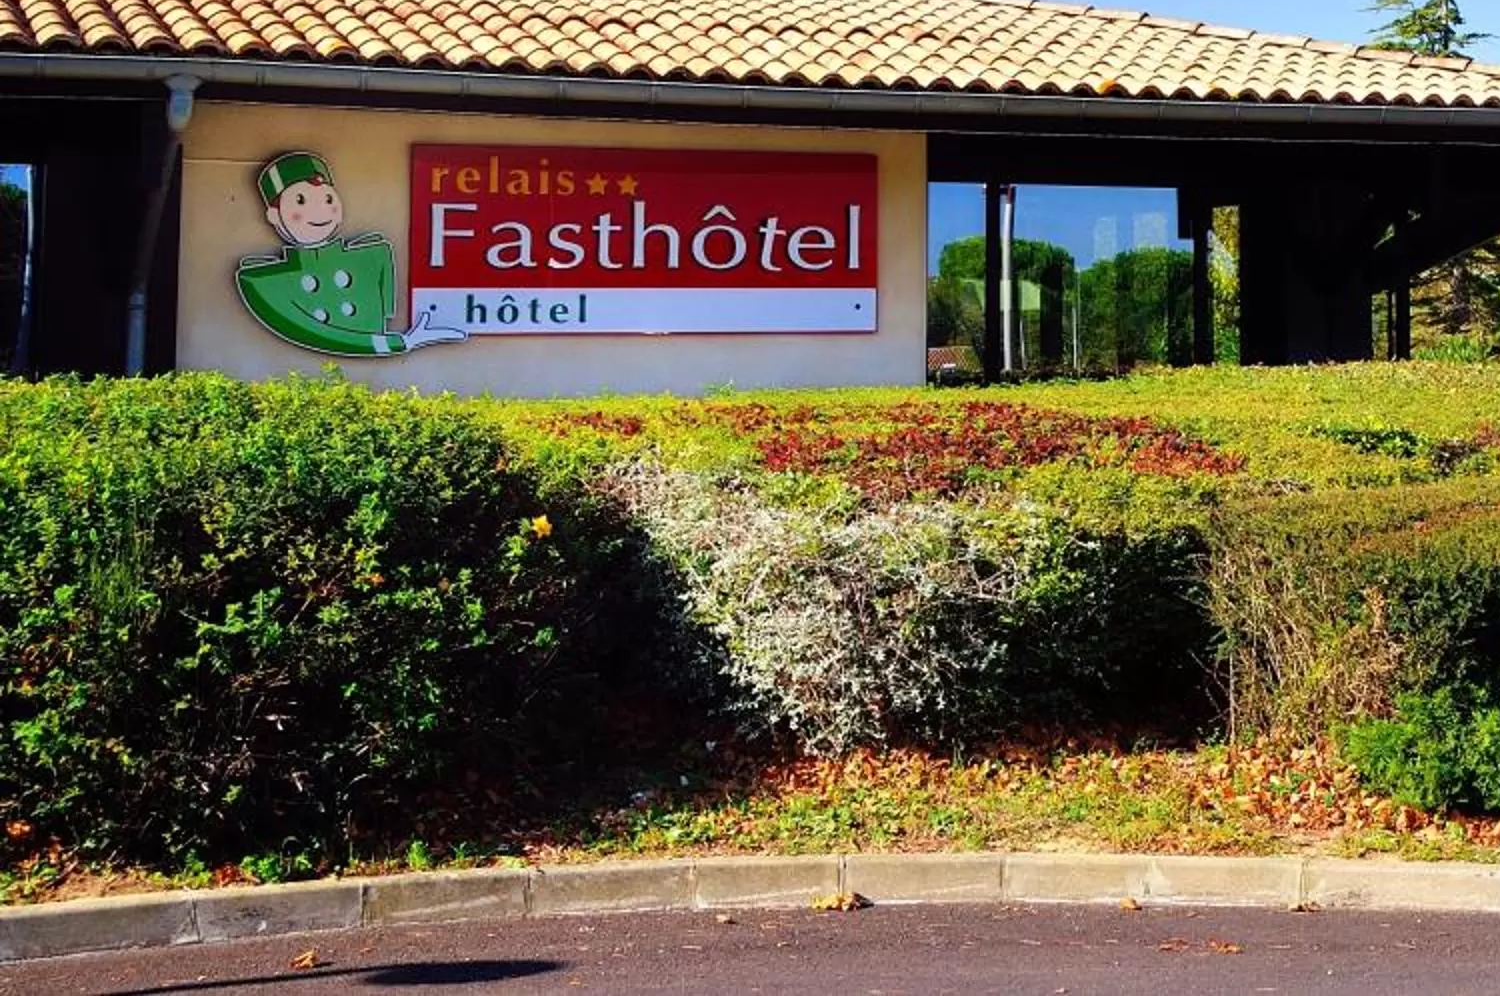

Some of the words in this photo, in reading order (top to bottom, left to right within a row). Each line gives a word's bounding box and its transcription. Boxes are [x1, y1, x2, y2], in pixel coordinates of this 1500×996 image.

[431, 156, 576, 195] relais
[429, 200, 861, 271] Fasthôtel
[466, 294, 587, 324] hôtel
